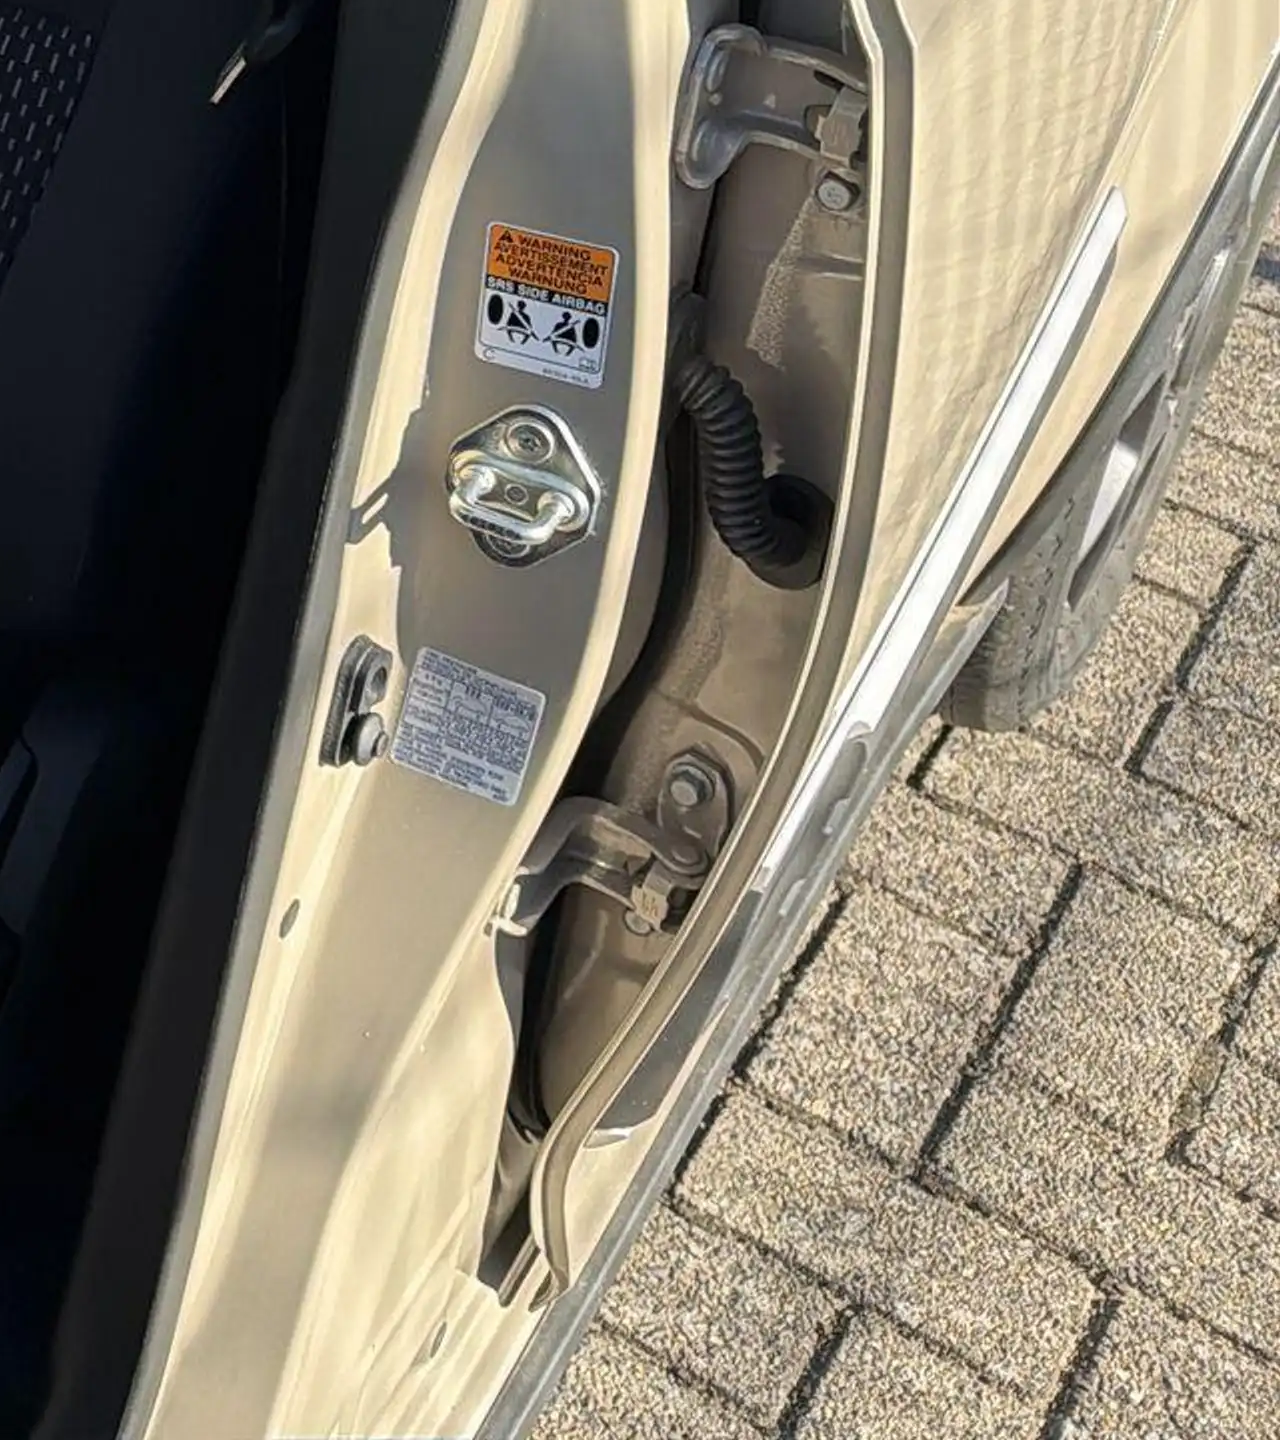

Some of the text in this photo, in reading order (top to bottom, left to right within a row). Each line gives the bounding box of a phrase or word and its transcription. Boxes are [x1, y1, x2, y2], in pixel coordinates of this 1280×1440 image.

[494, 241, 609, 276] AVERTISSEMENT
[518, 234, 592, 261] WARNING
[495, 253, 603, 287] ADVERTENCIA
[508, 268, 588, 295] WARNUNG
[487, 276, 606, 315] SRS SIDE AIRBAG
